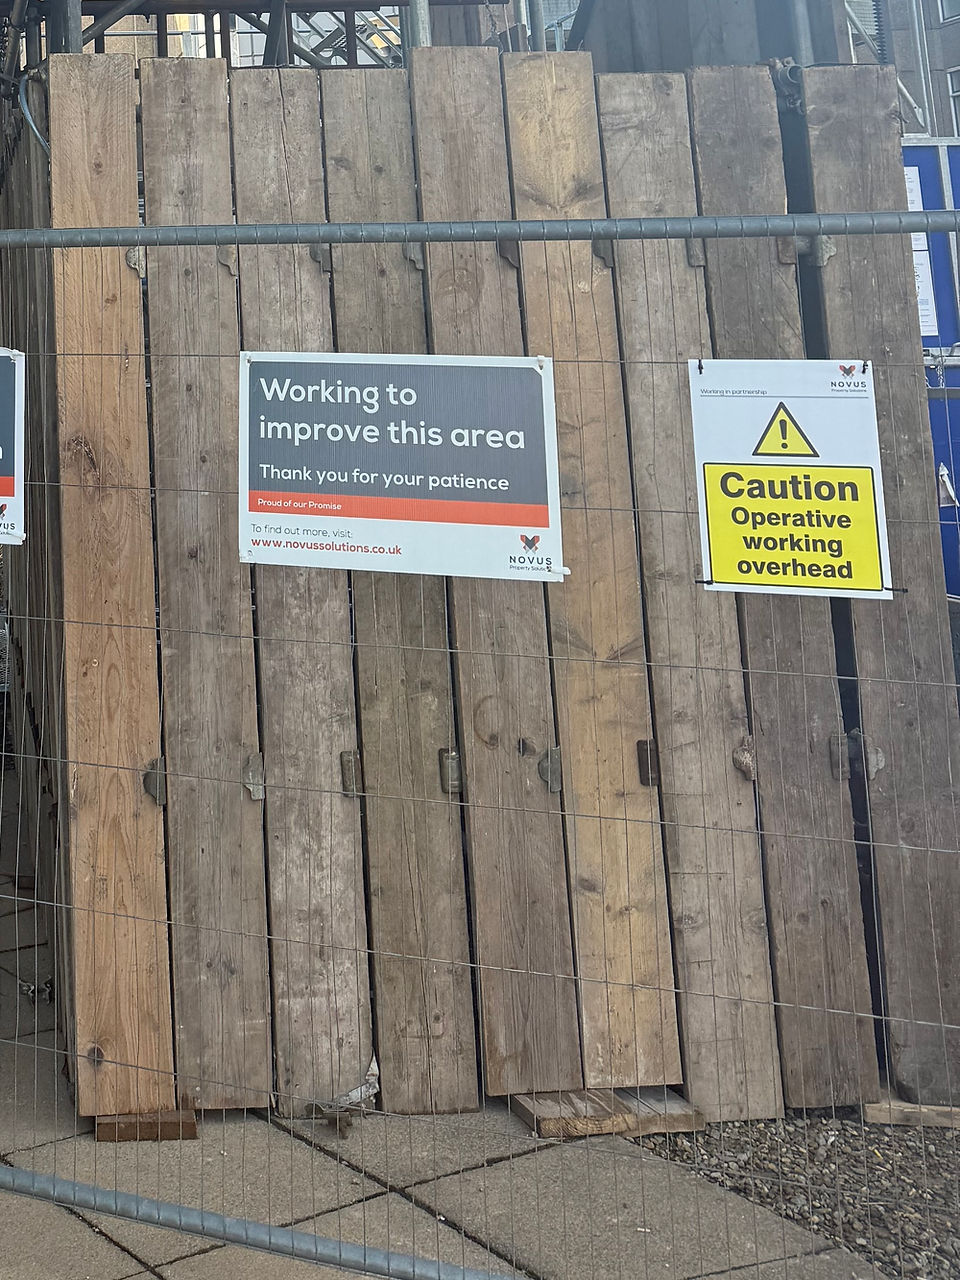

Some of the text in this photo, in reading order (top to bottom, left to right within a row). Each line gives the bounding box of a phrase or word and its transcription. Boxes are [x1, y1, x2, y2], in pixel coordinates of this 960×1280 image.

[259, 377, 418, 414] Working to
[259, 415, 526, 449] improve this area
[259, 464, 510, 491] Thank you for your patience
[719, 471, 859, 502] Caution
[257, 498, 282, 507] Proud
[283, 499, 293, 507] of
[308, 501, 342, 510] Promise
[731, 506, 852, 530] Operative
[251, 523, 353, 539] To find out more, visit:
[251, 538, 402, 555] www.novussolutions.co.uk
[742, 533, 843, 558] working
[509, 555, 552, 566] NOVUS
[737, 558, 853, 579] overhead
